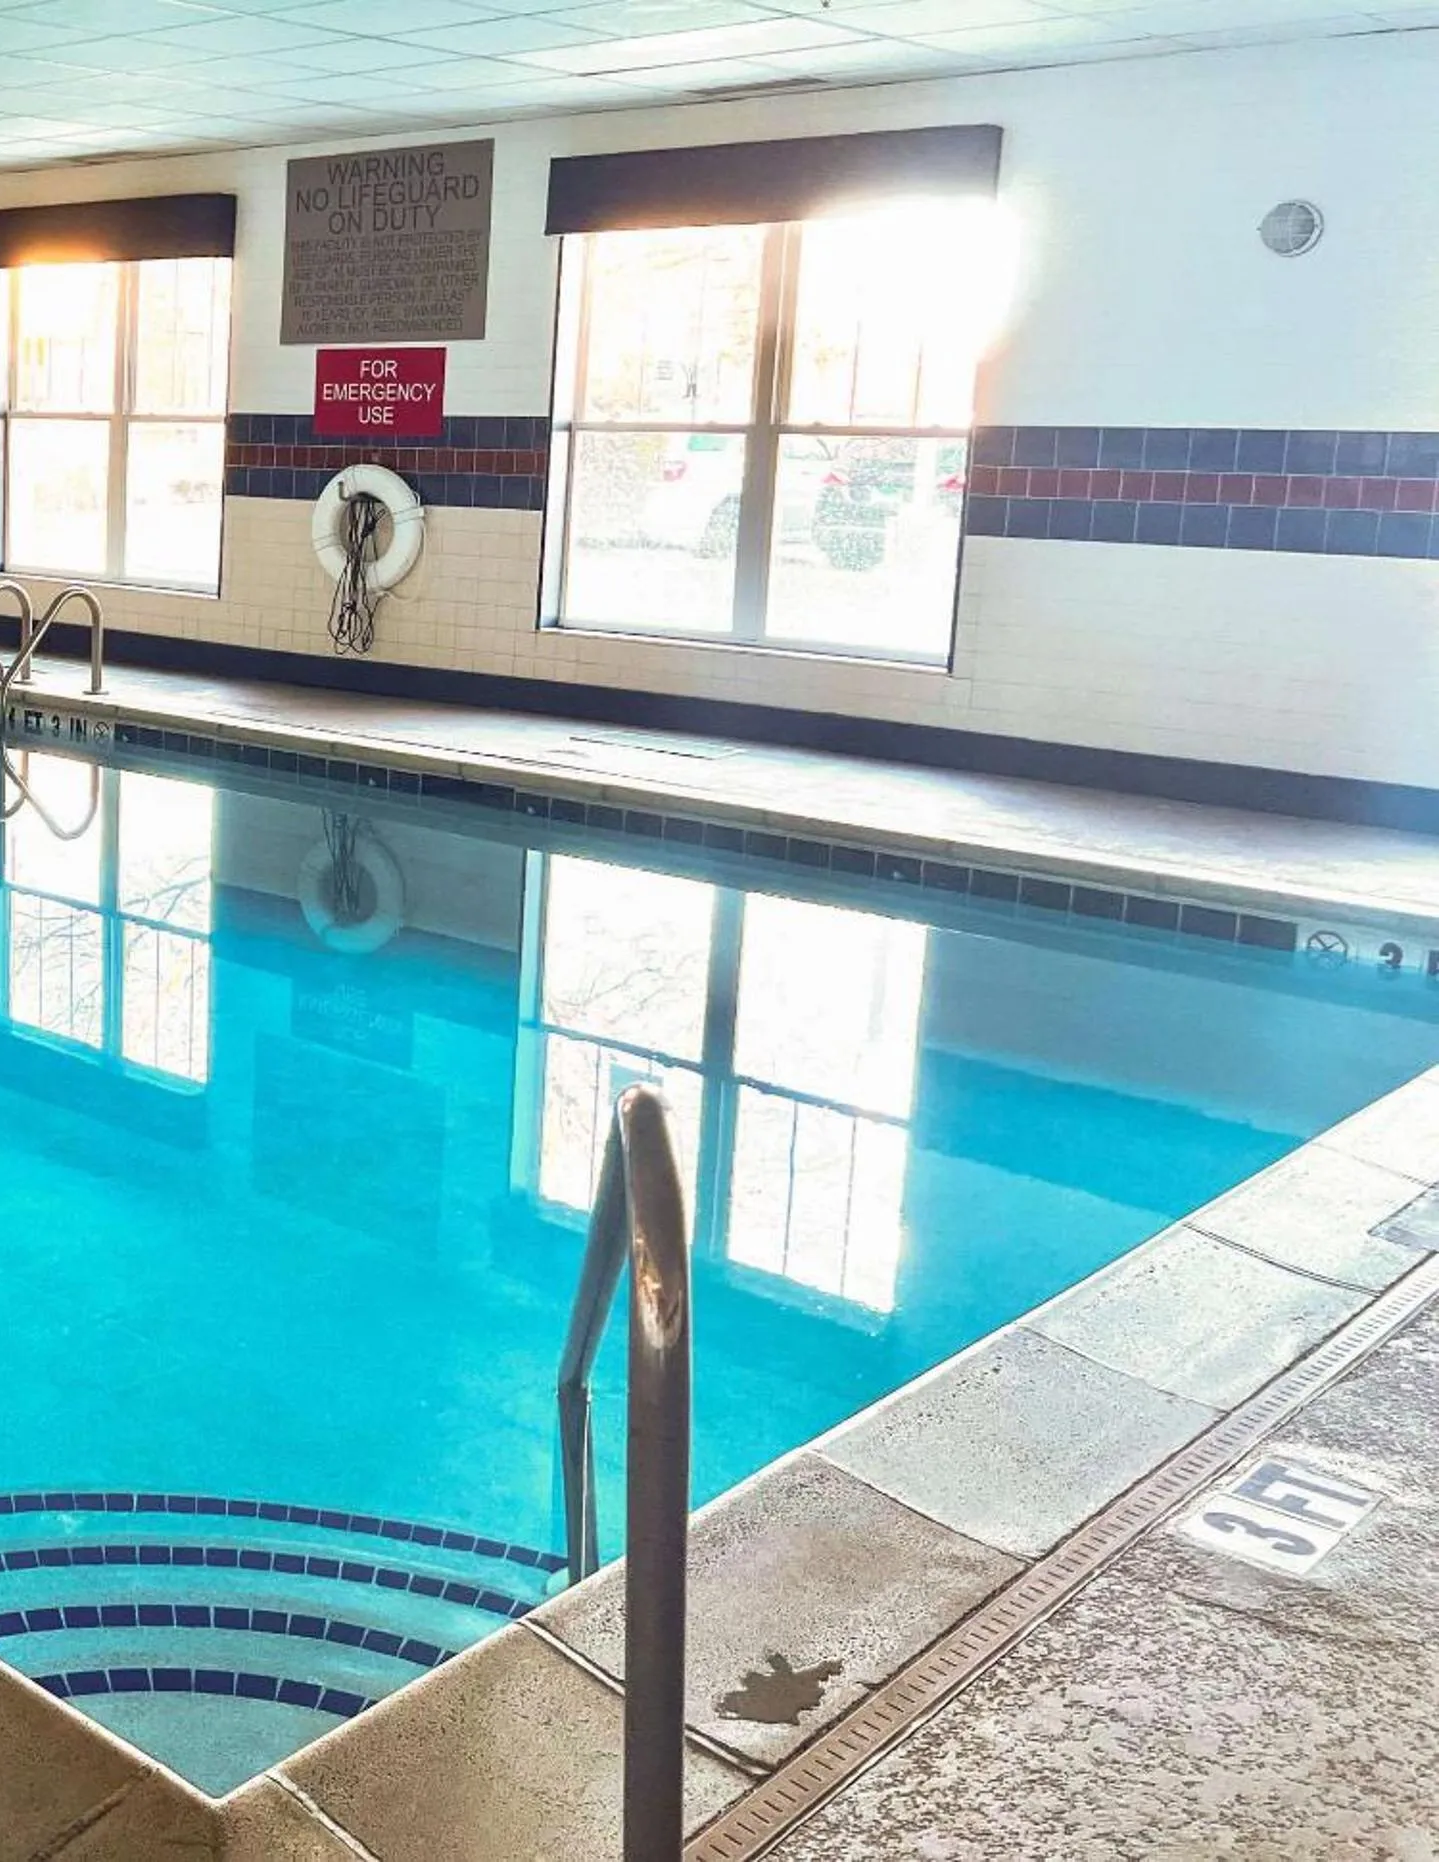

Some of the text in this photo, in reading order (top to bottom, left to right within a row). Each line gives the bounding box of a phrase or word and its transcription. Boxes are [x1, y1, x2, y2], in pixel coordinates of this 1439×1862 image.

[328, 151, 445, 185] WARNING
[296, 174, 480, 213] NO LIFEGUARD
[328, 204, 443, 235] ON DUTY
[374, 235, 394, 247] NOT
[360, 360, 398, 378] FOR
[323, 382, 436, 402] EMERGENCY
[359, 406, 394, 425] USE
[1202, 1461, 1371, 1556] 3 FT
